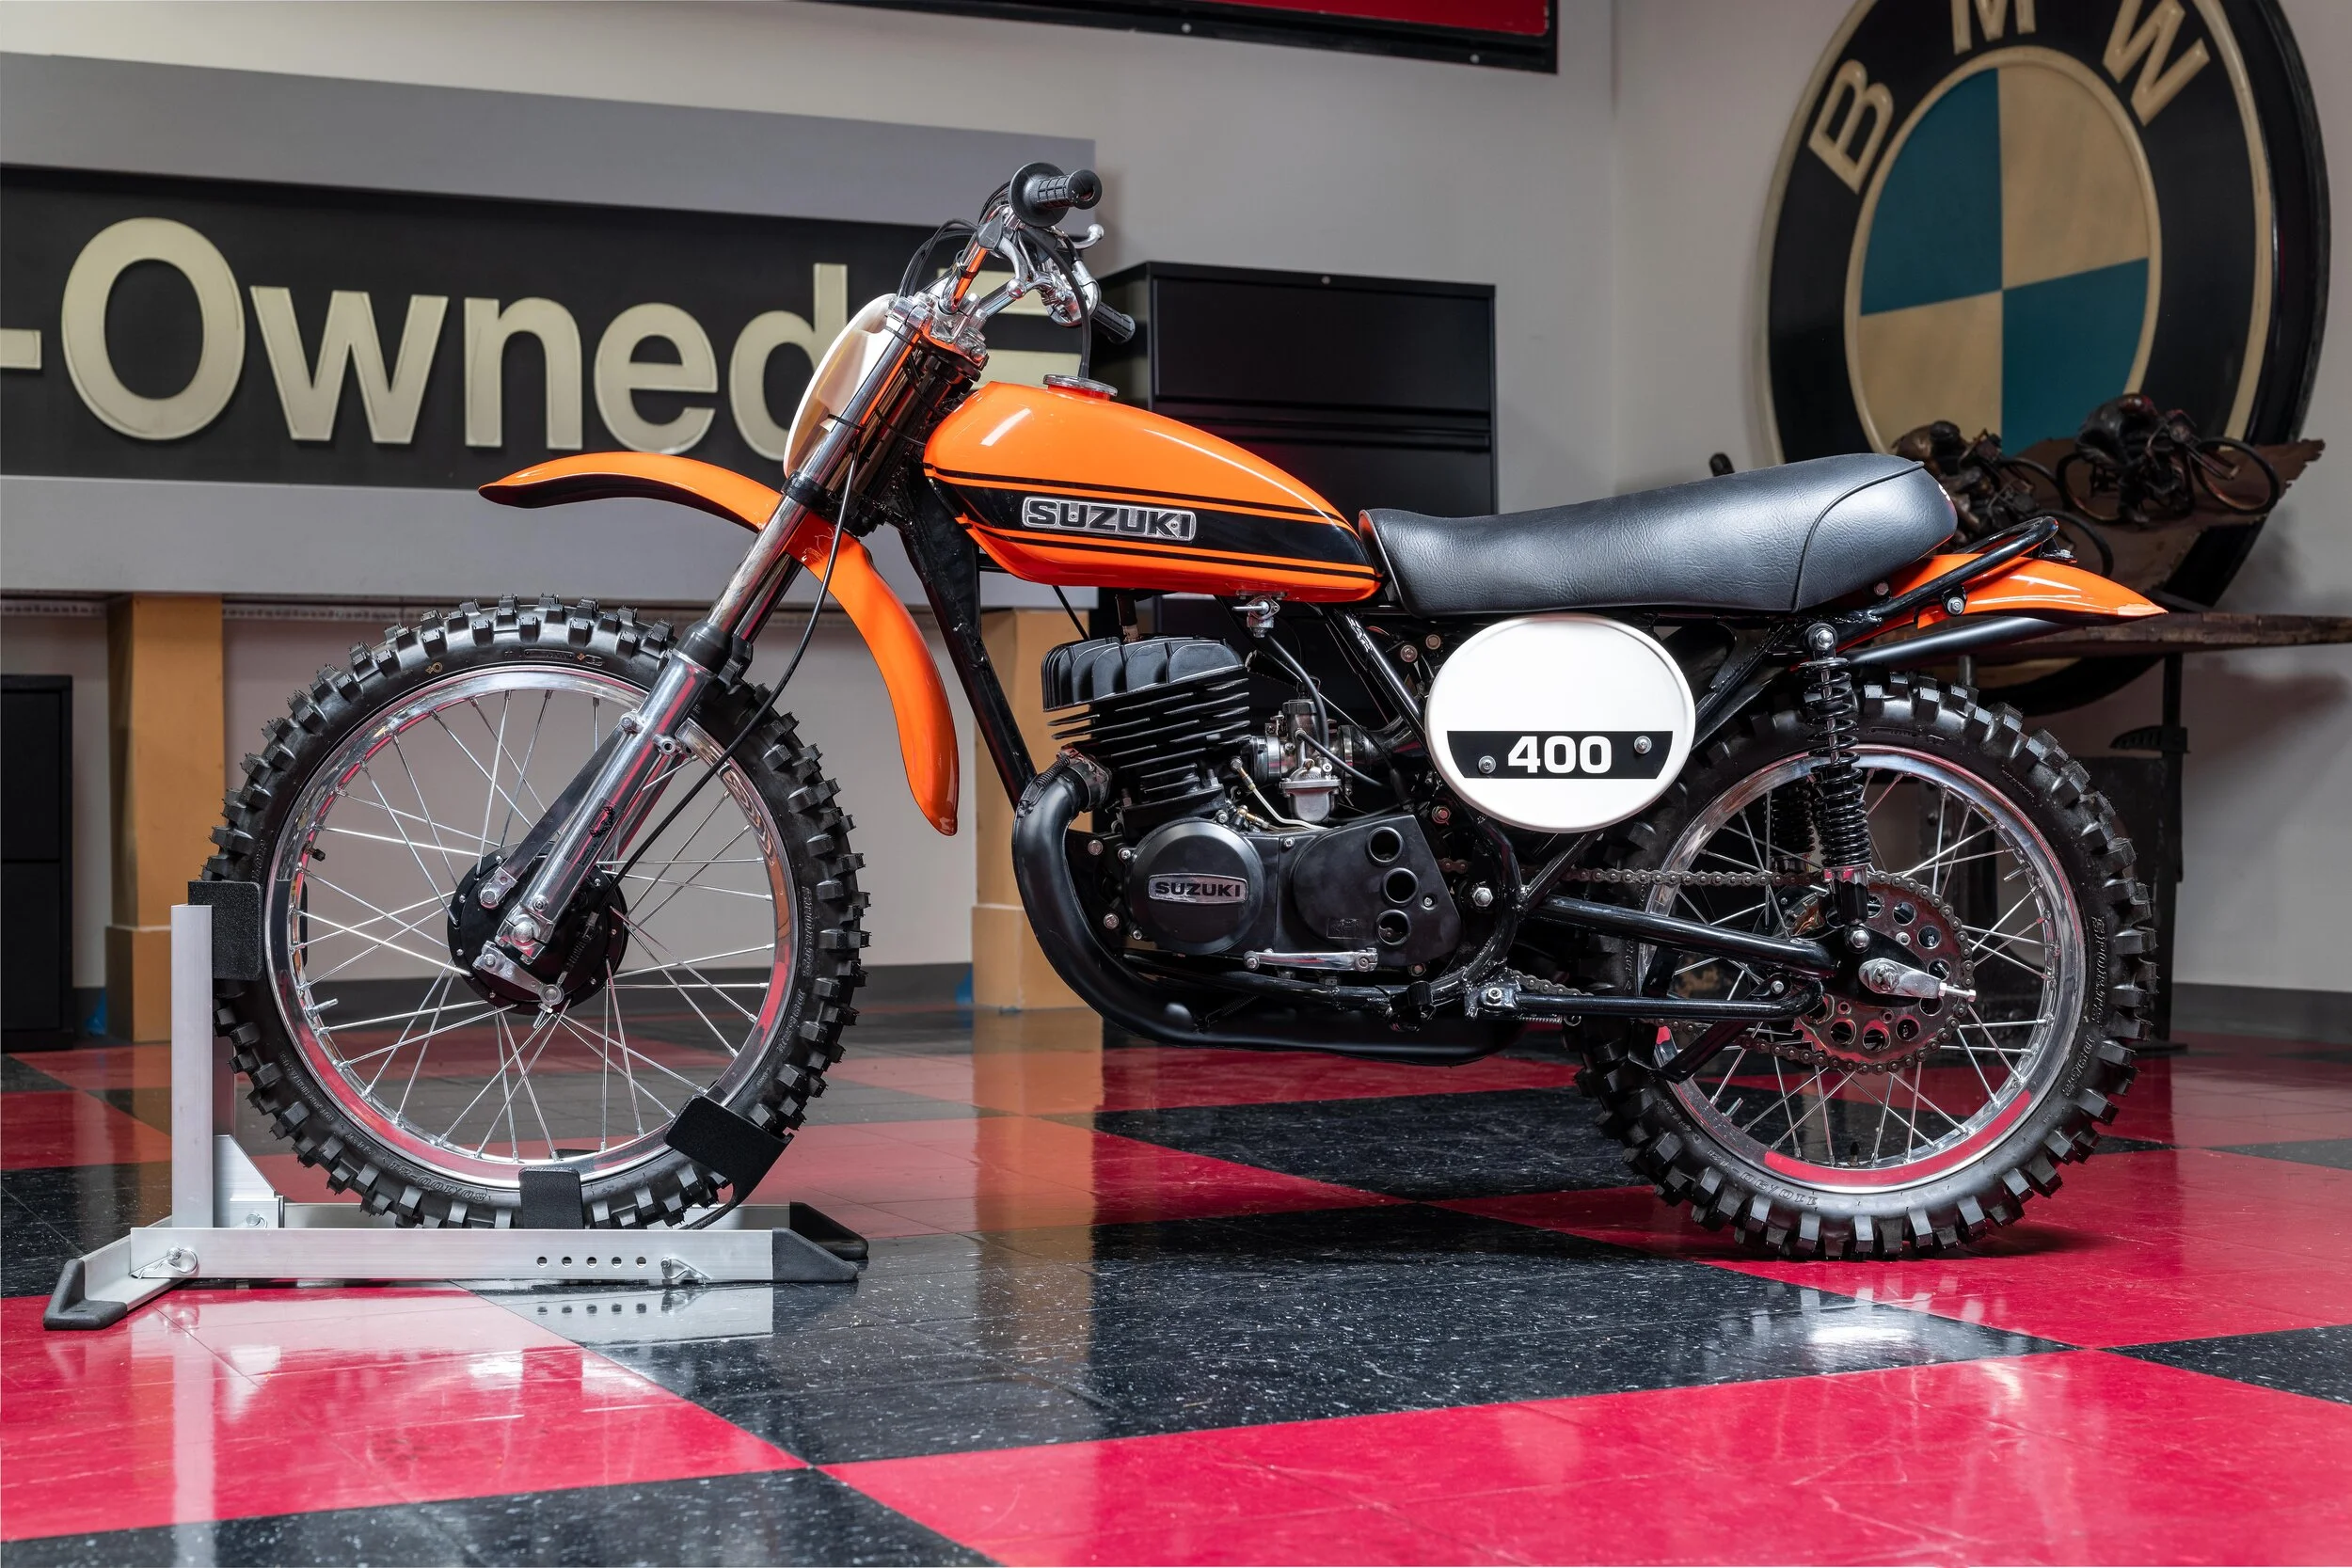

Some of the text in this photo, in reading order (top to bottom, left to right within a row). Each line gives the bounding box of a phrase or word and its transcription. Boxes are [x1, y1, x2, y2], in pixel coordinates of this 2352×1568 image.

[1025, 499, 1192, 539] SUZUKI
[1507, 735, 1613, 774] 400
[1154, 881, 1241, 897] SUZUKI
[388, 1162, 486, 1202] 80/100-21
